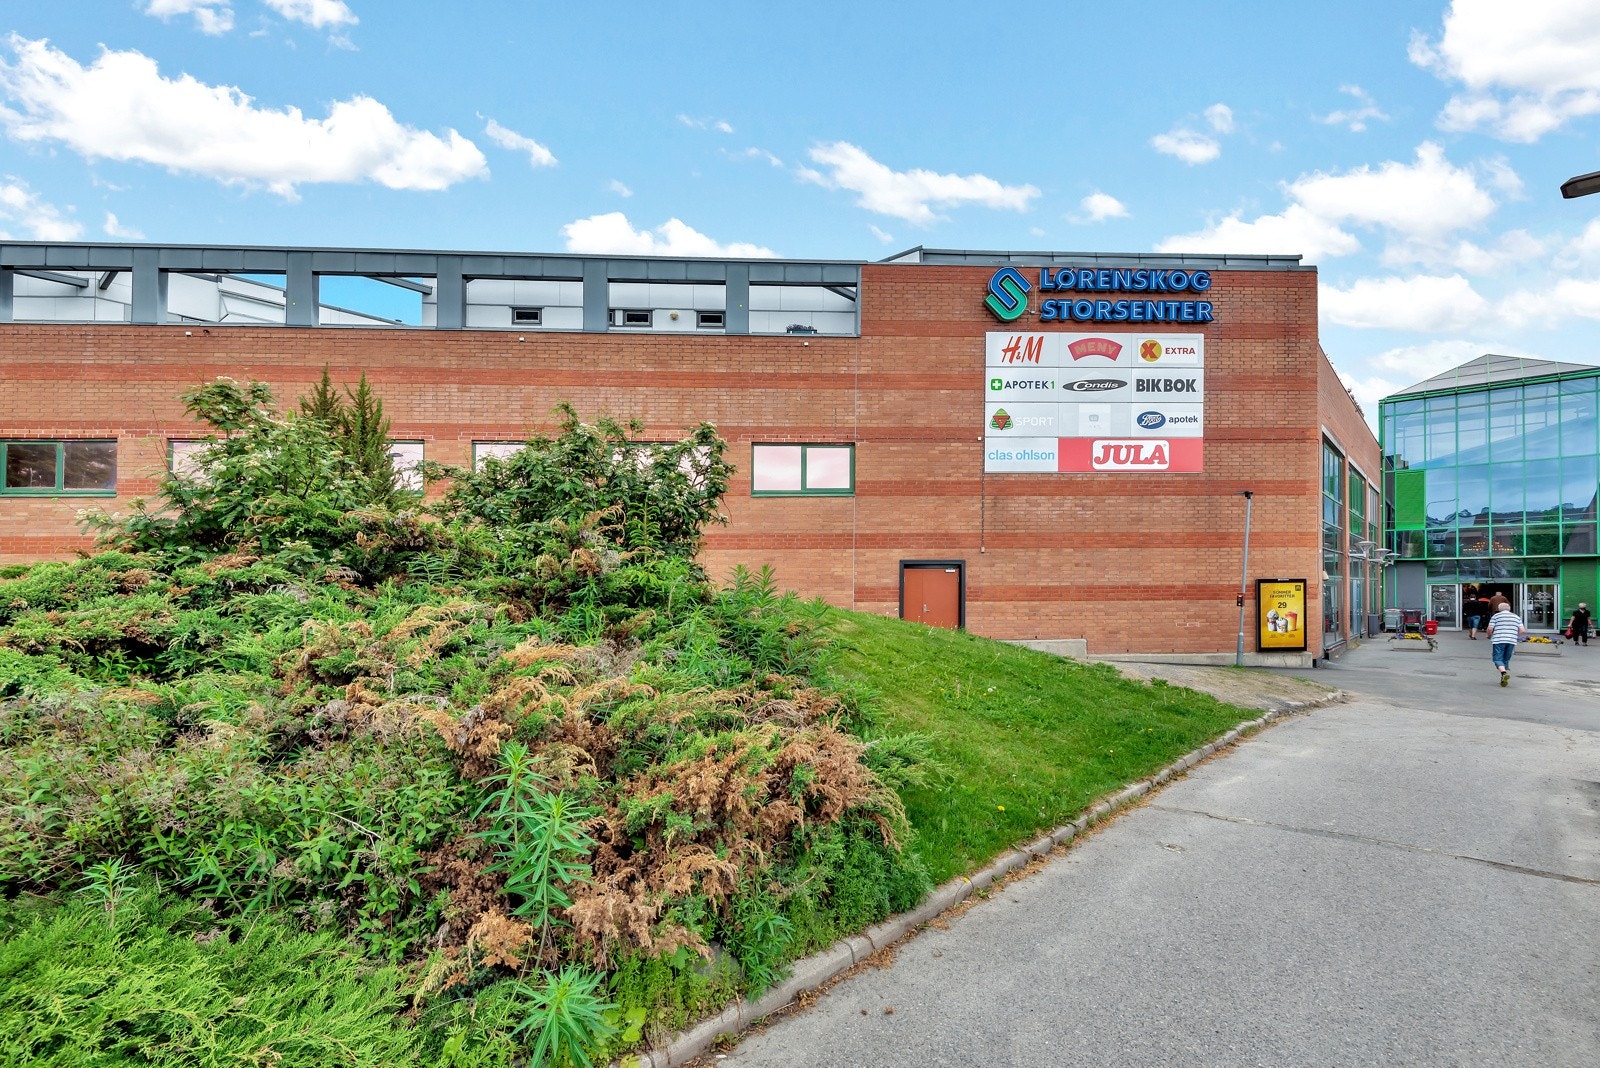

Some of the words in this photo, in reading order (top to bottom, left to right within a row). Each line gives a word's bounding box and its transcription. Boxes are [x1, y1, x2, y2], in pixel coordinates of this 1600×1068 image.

[1040, 267, 1212, 292] LØRENSKOG
[1040, 298, 1214, 323] STORSENTER
[1002, 336, 1044, 364] H&M
[1074, 341, 1117, 355] MENY
[1165, 347, 1196, 355] EXTRA
[1004, 380, 1049, 390] APOTEK
[1050, 380, 1055, 390] 1
[1073, 381, 1119, 391] Condis
[1136, 378, 1162, 393] BIK
[1163, 378, 1197, 393] BOK
[1015, 416, 1054, 426] SPORT
[1168, 415, 1199, 424] apotek
[988, 450, 1013, 460] clas
[1015, 449, 1055, 460] ohlson
[1094, 444, 1168, 465] JULA
